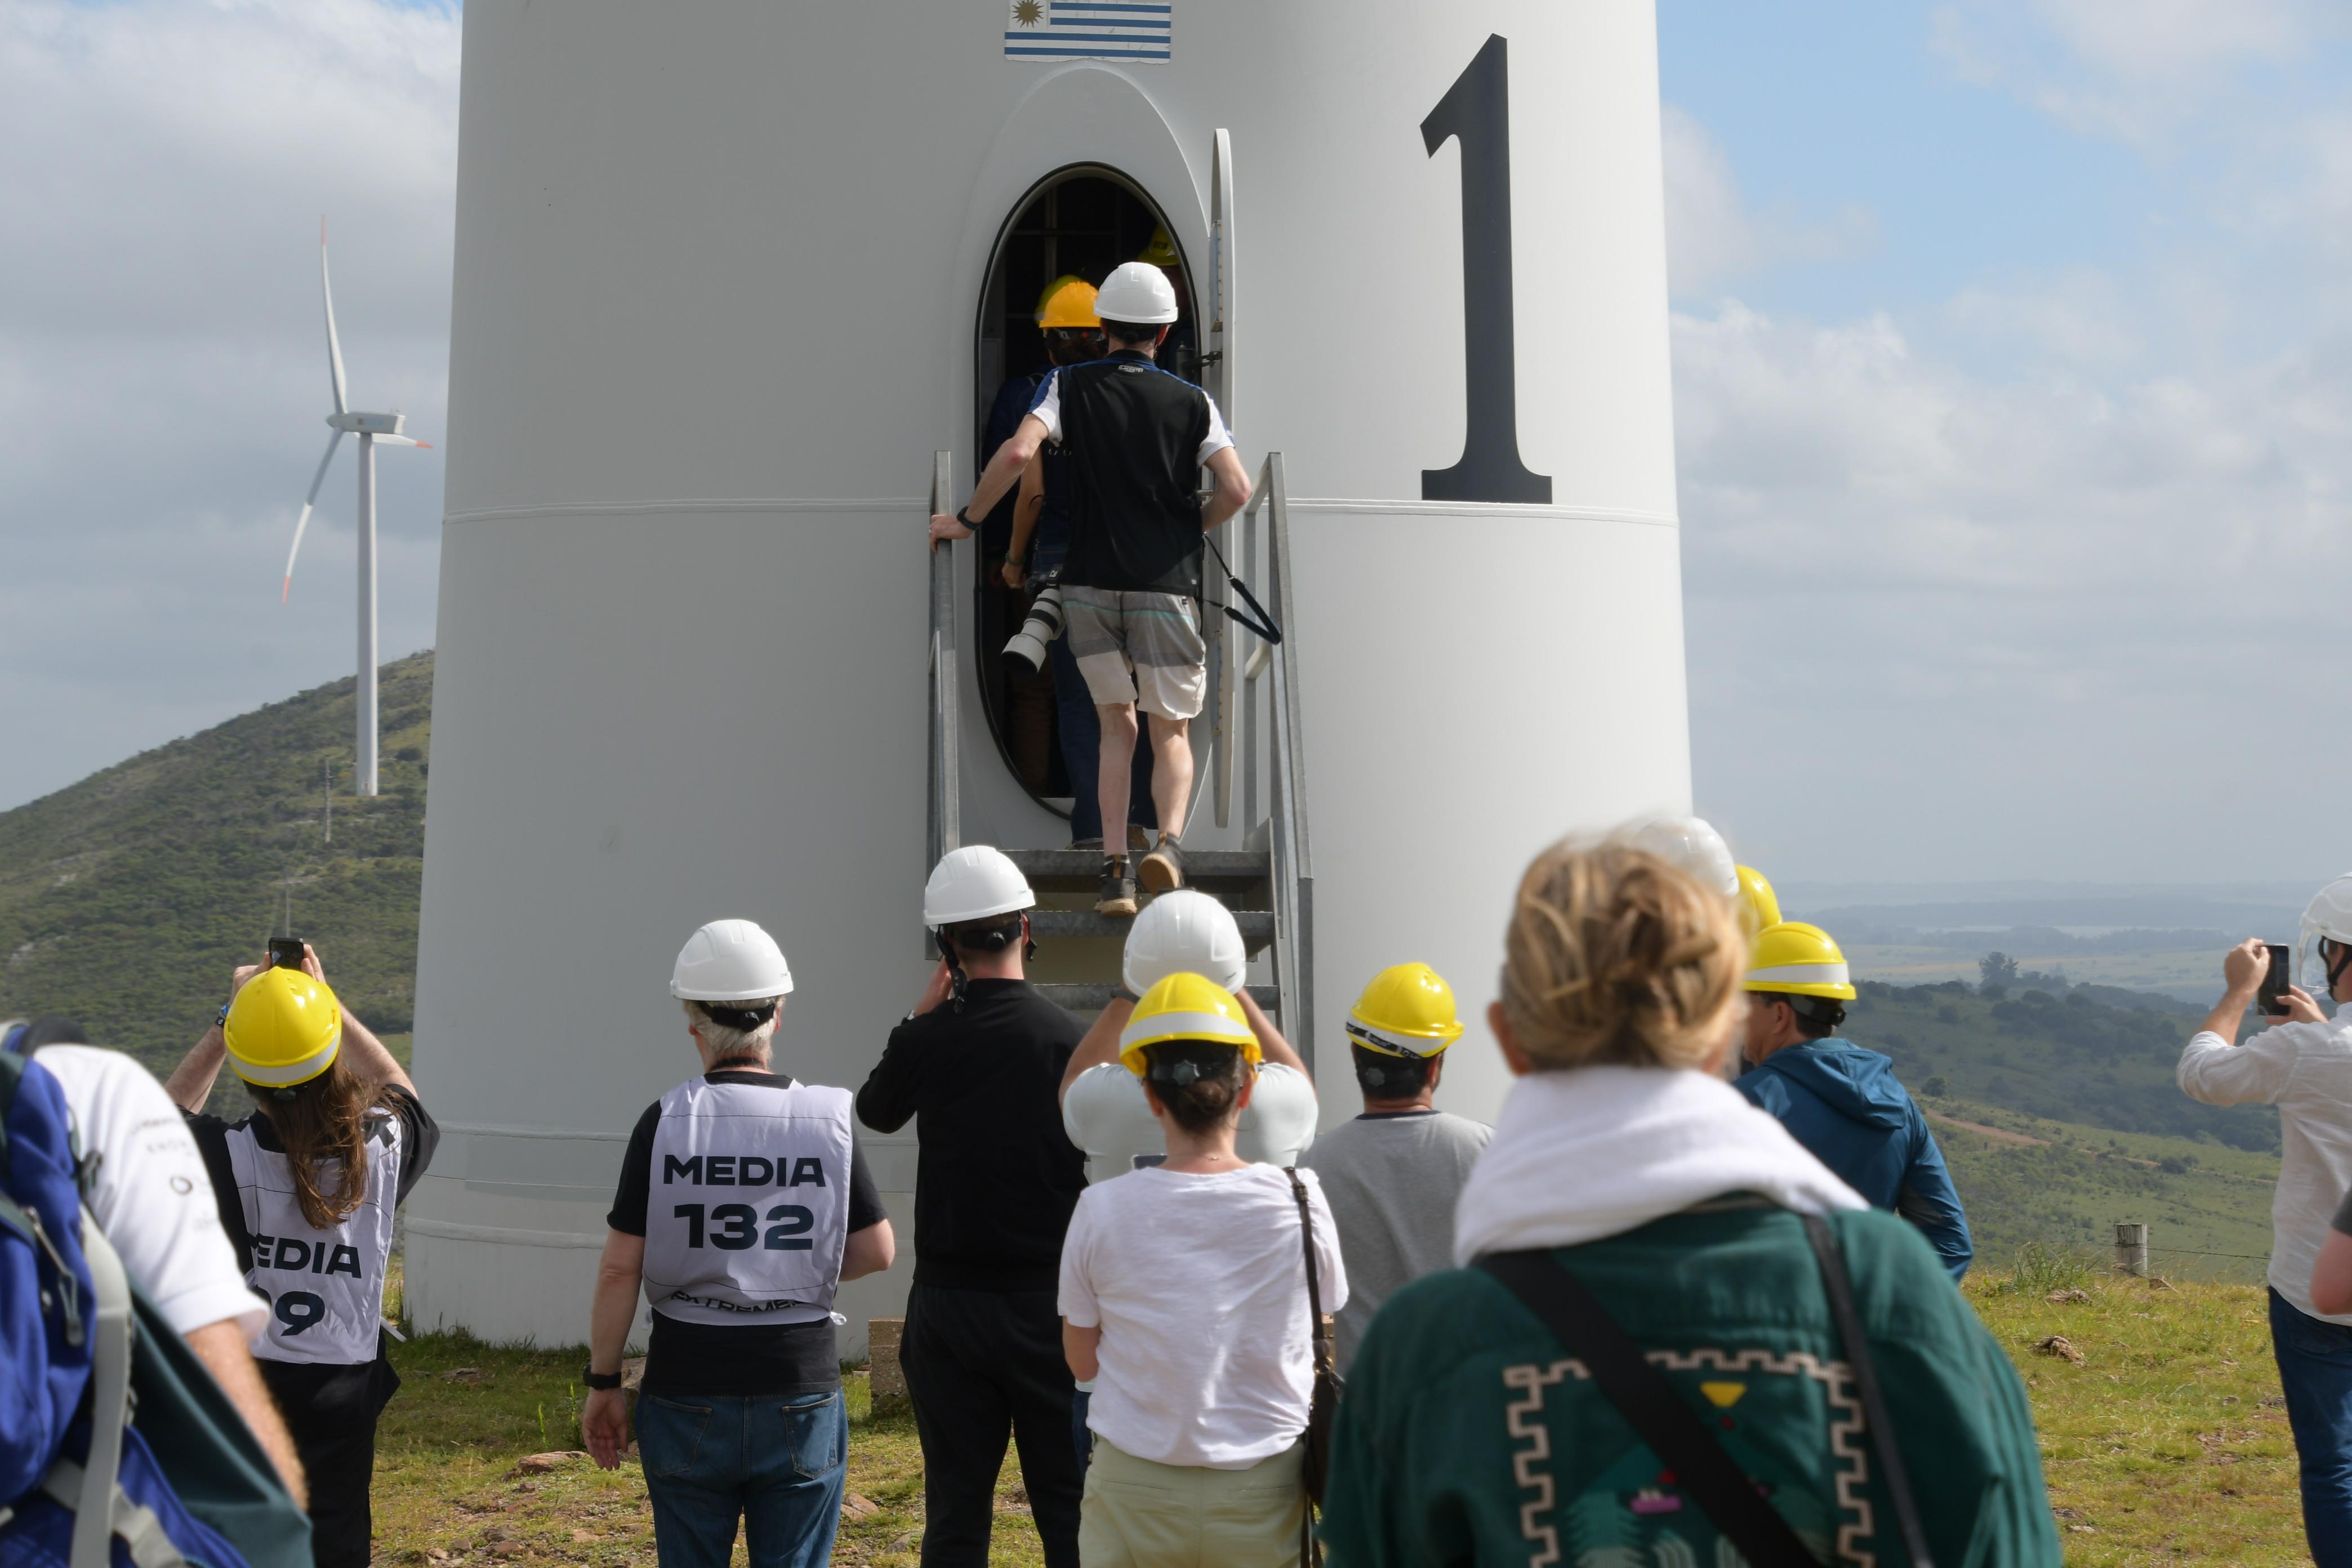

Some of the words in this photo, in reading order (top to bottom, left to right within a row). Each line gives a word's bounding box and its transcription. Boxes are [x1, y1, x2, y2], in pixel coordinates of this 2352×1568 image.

[1420, 33, 1553, 504] 1
[663, 1154, 826, 1188] MEDIA
[674, 1203, 814, 1251] 132
[257, 1285, 326, 1337] 9
